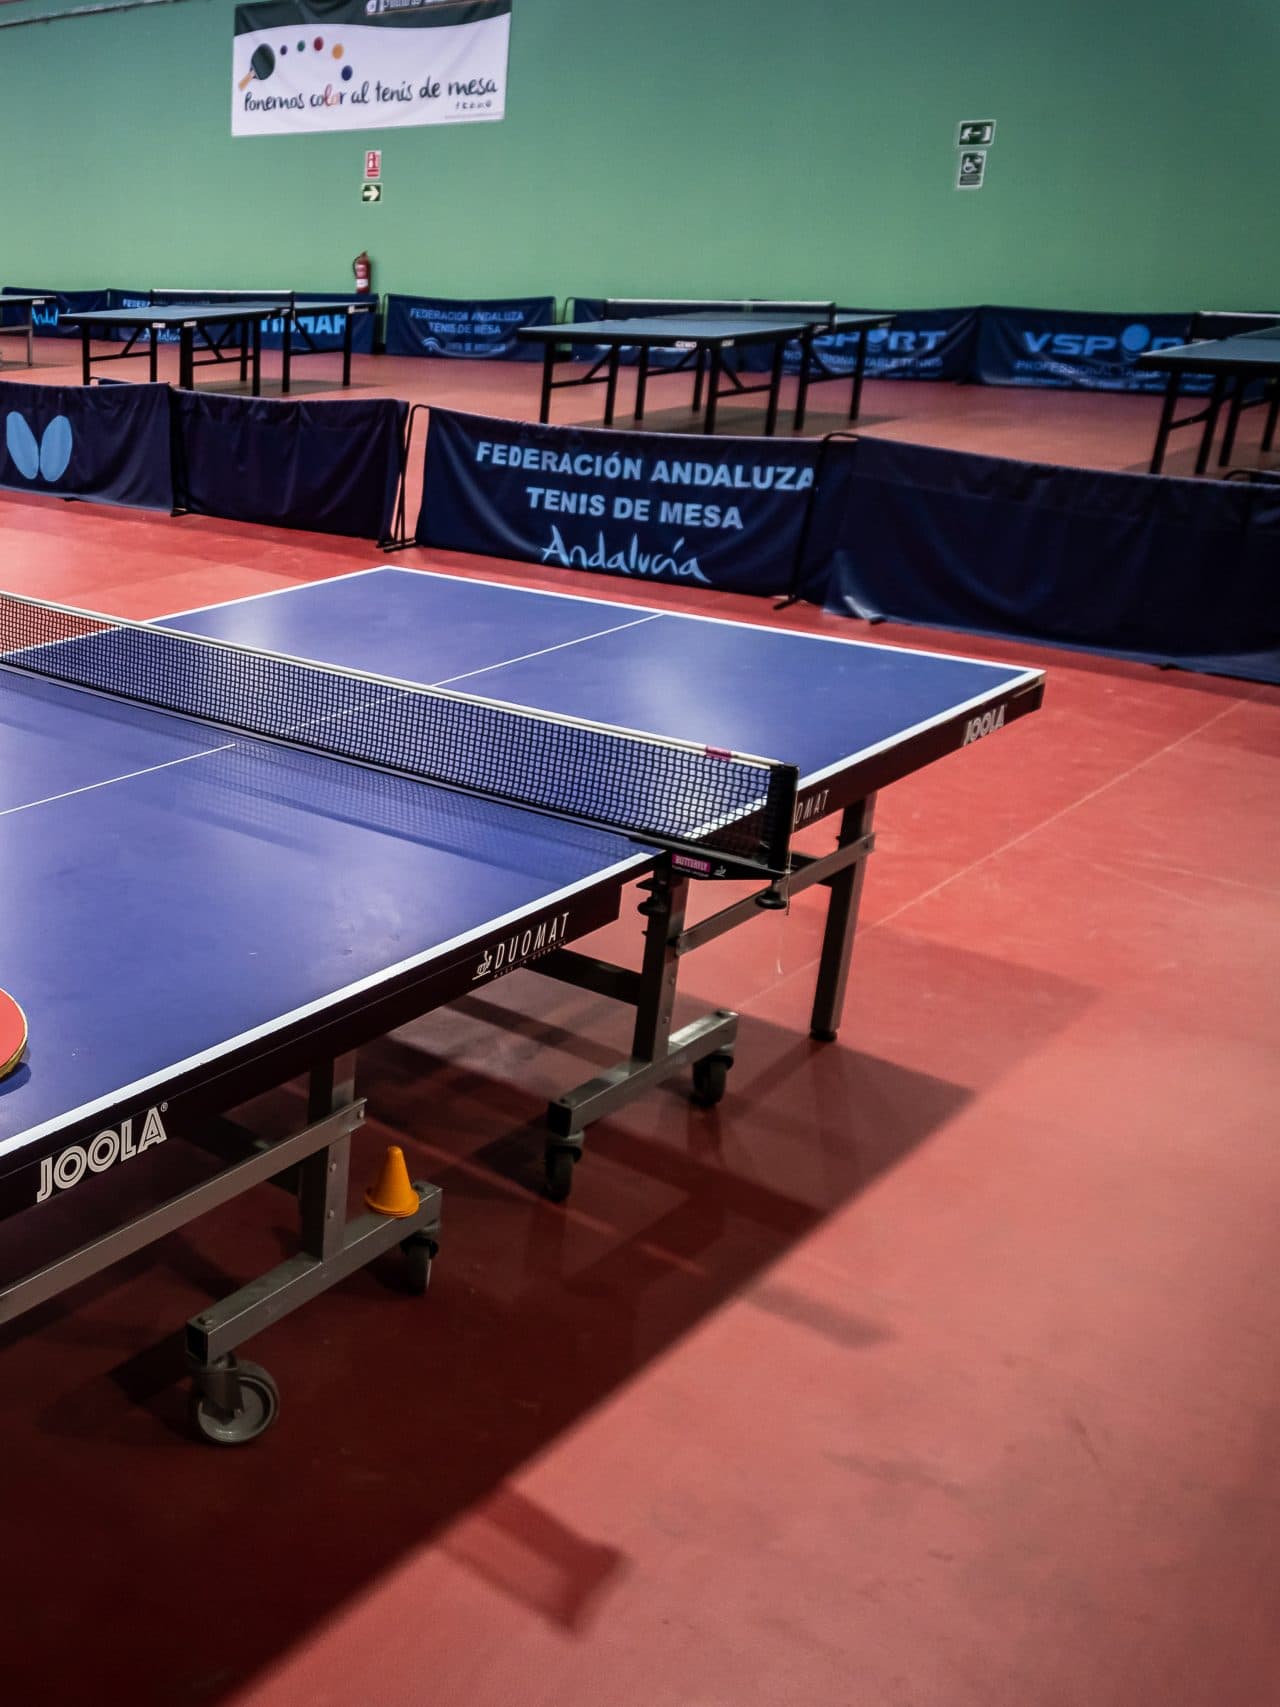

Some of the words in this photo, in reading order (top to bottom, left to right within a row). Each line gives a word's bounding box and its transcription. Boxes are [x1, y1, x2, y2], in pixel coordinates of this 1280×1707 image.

[244, 92, 304, 112] Ponemos
[310, 84, 346, 108] color
[351, 80, 369, 104] al
[376, 80, 413, 102] tenis
[419, 75, 440, 99] de
[448, 77, 497, 97] mesa
[471, 309, 524, 322] ANDALUZA
[476, 441, 642, 480] FEDERACIÓN
[651, 460, 814, 491] ANDALUZA
[526, 487, 605, 517] TENIS
[613, 497, 650, 522] DE
[659, 500, 744, 530] MESA
[541, 524, 712, 584] Andalucía
[675, 854, 707, 872] BUTTERFLY
[495, 911, 570, 970] DUOMAT
